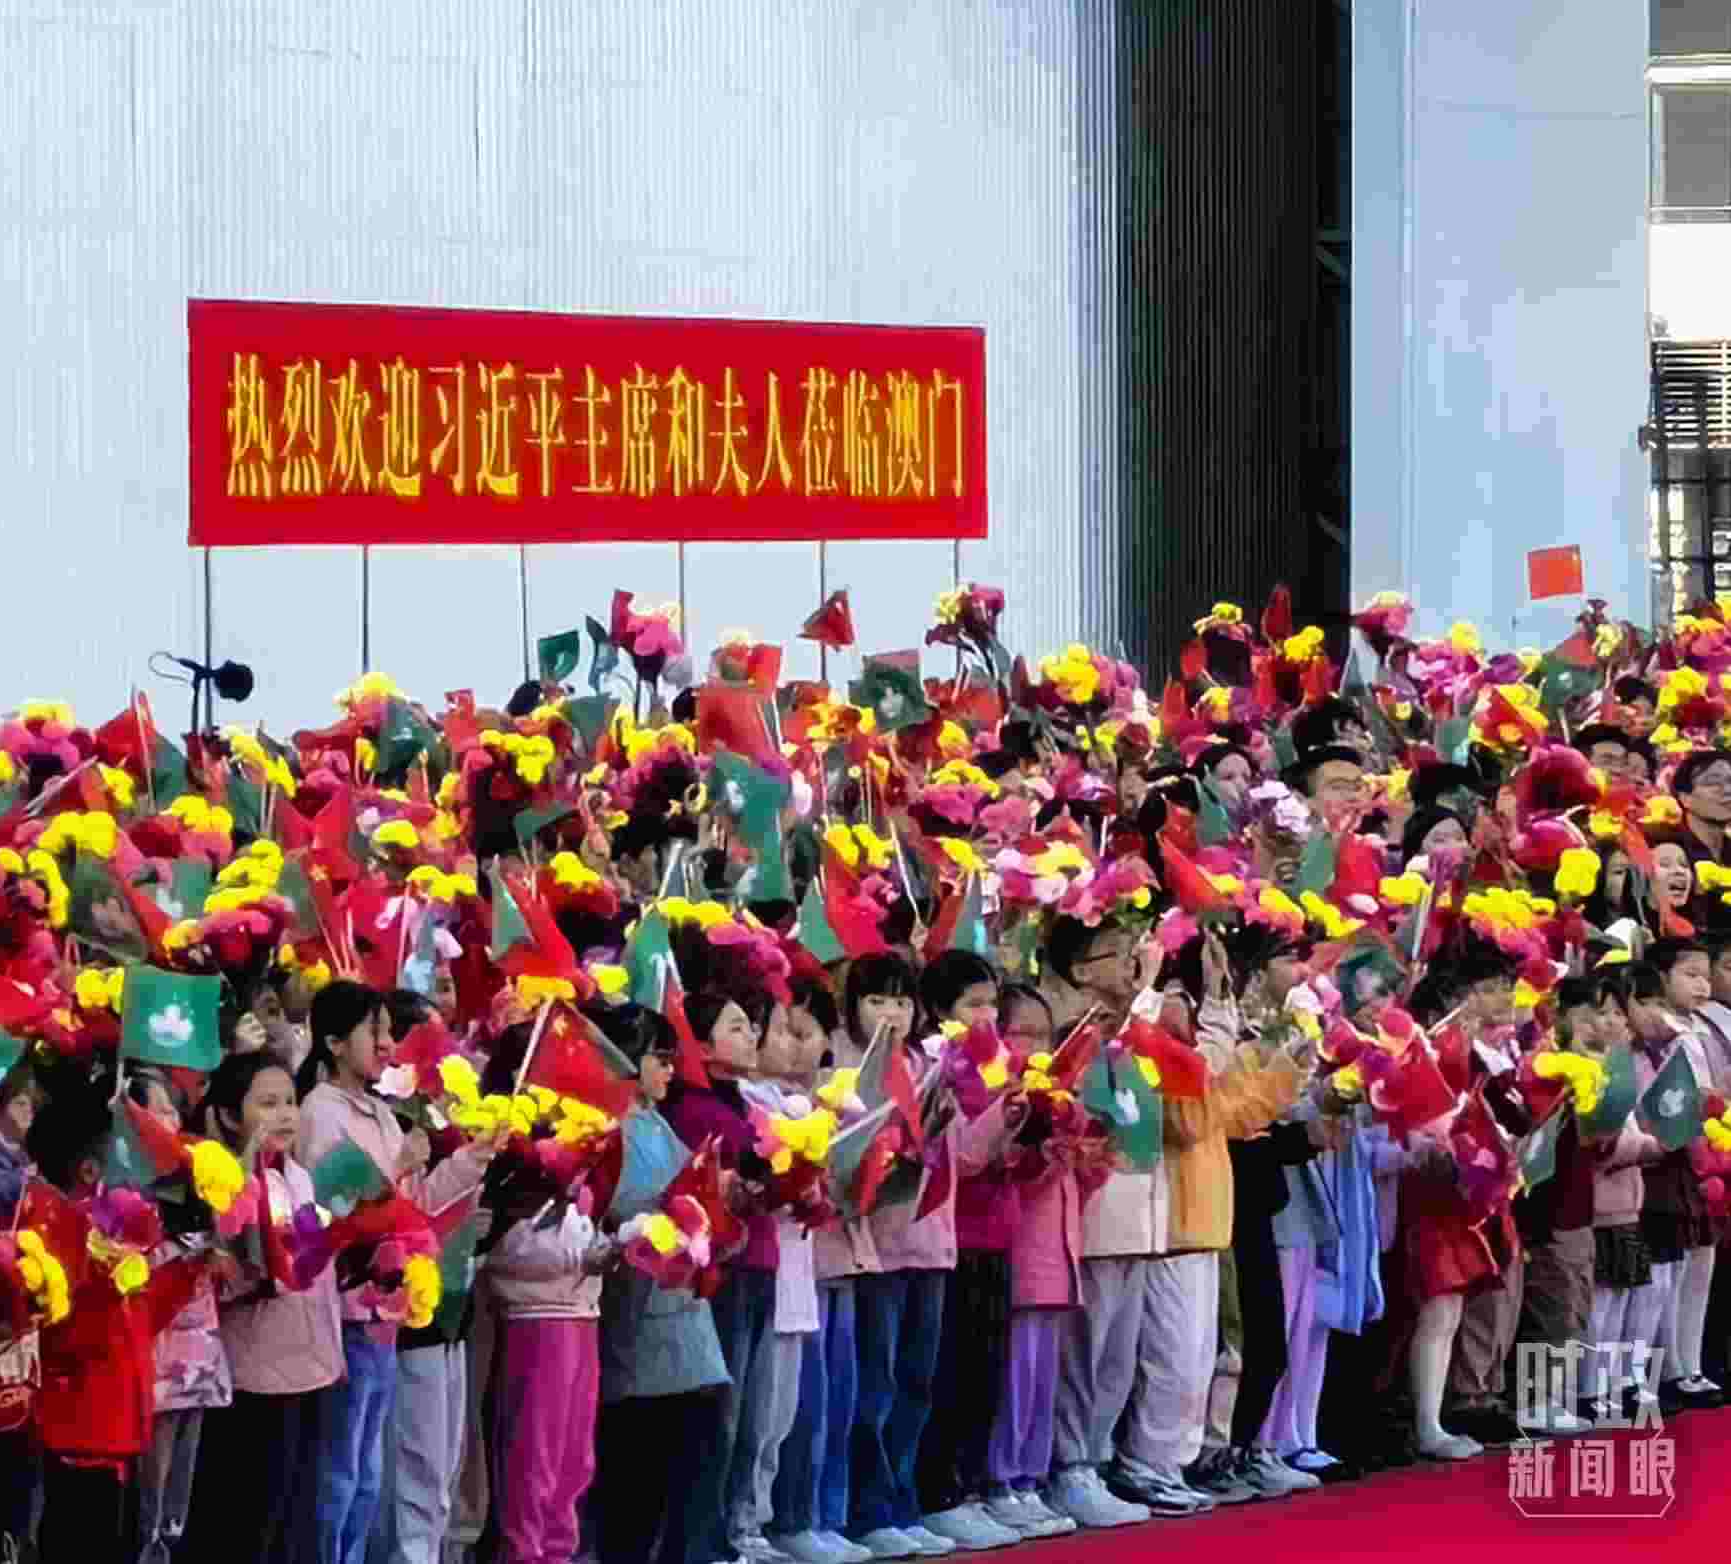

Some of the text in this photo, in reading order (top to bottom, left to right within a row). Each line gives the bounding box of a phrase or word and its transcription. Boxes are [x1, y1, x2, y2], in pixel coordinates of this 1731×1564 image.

[226, 353, 964, 499] 热烈欢迎习近平主席和夫人莅临澳门
